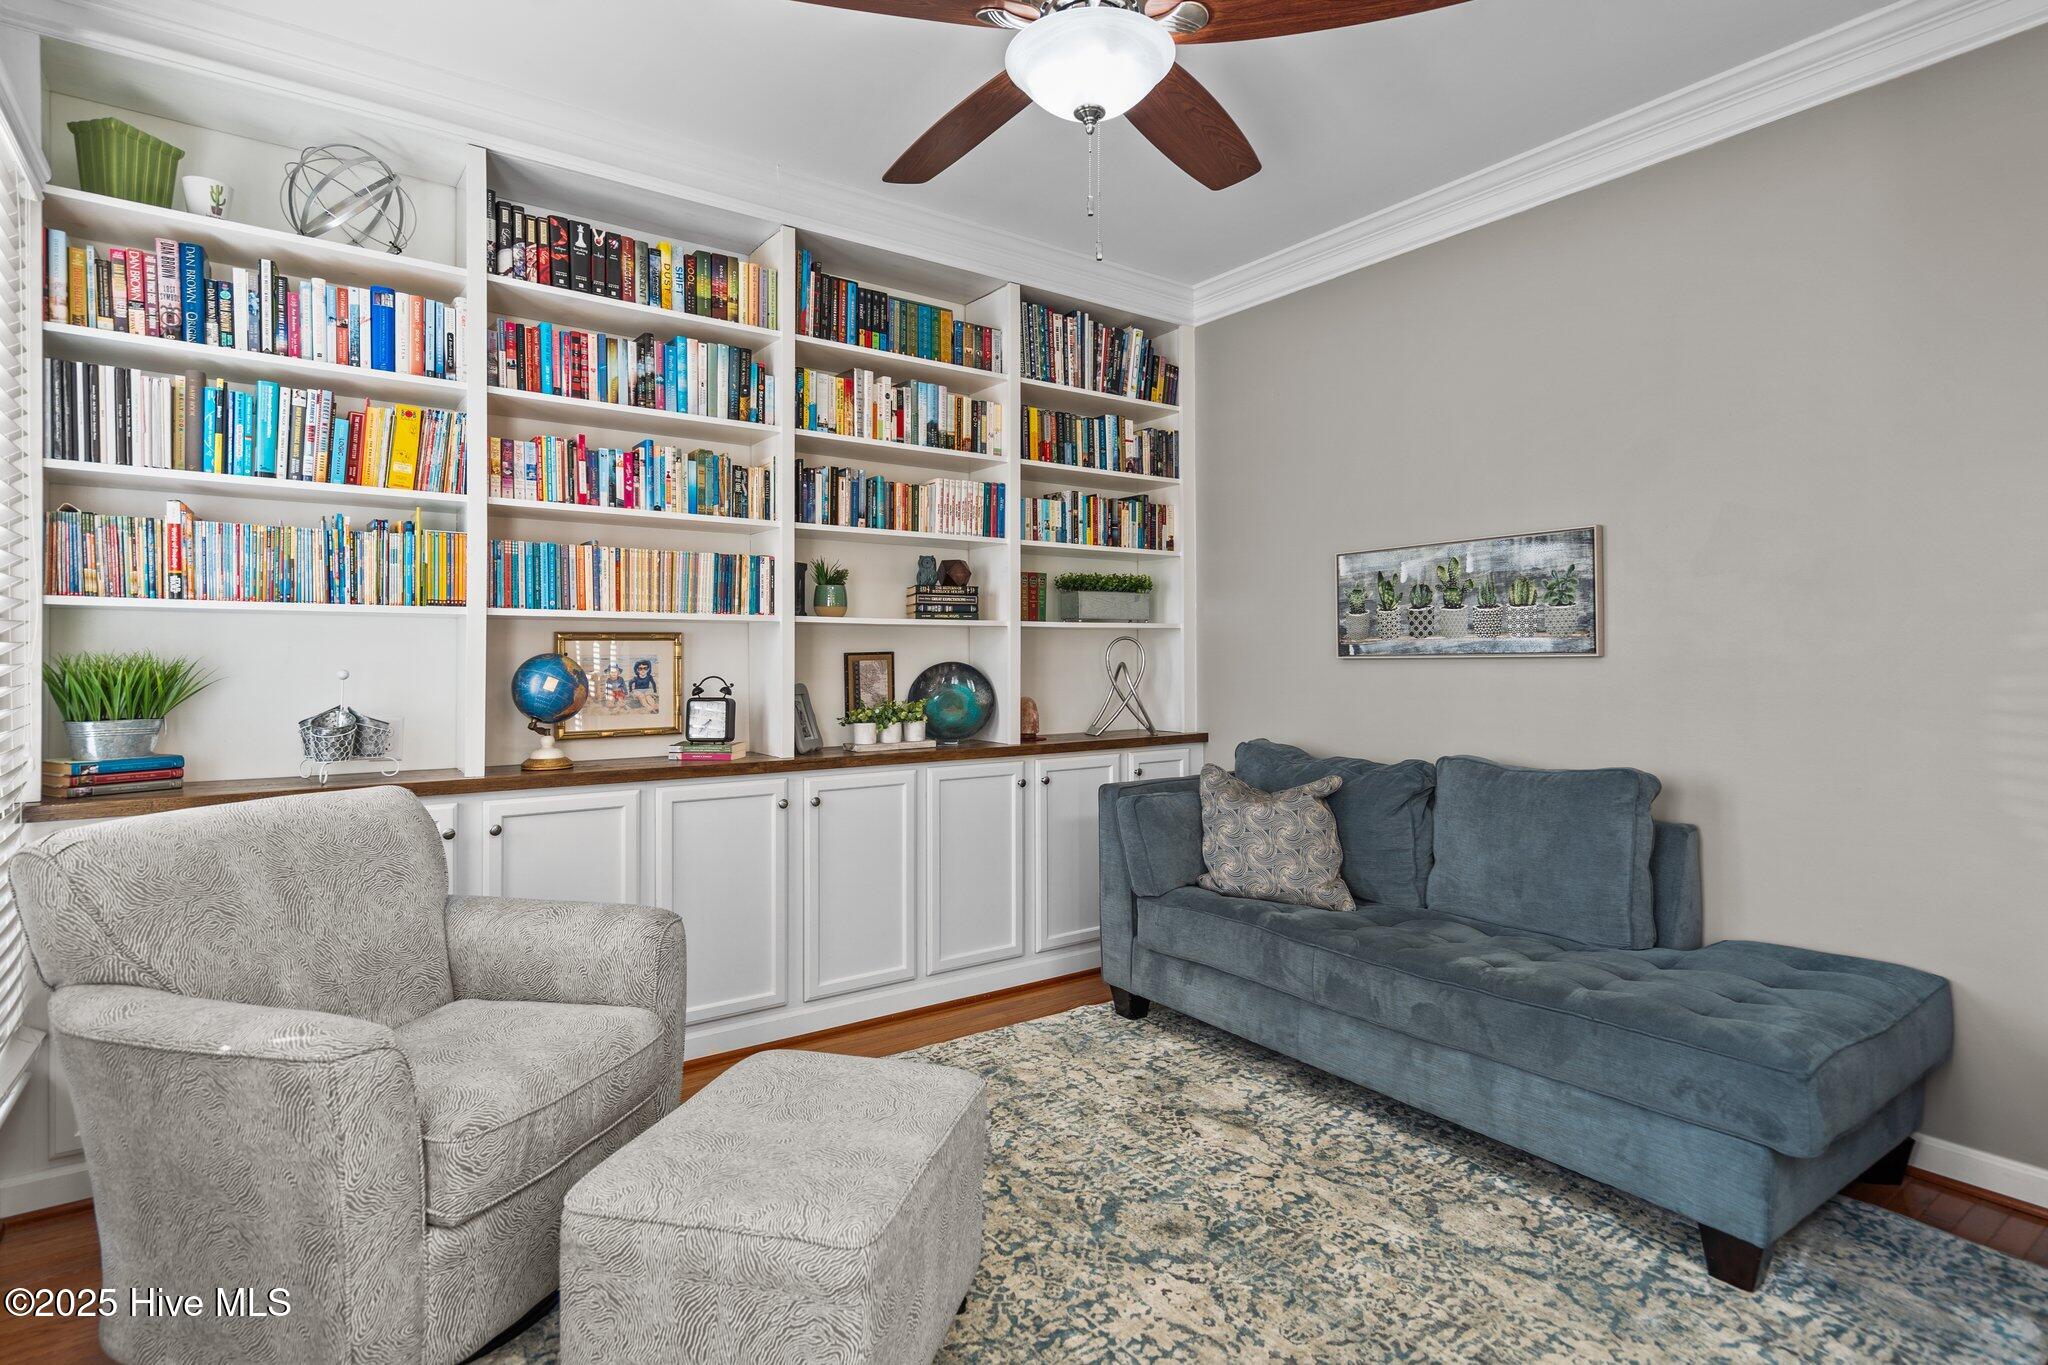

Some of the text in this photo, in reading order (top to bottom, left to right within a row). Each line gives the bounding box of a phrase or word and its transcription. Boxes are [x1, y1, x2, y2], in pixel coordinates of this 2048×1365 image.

[130, 250, 140, 270] DAN
[160, 242, 177, 281] DAN BROWN
[186, 246, 197, 267] DAN
[130, 270, 142, 302] BROWN
[186, 269, 197, 304] BROWN
[624, 252, 632, 297] ALLEGIANT
[664, 262, 672, 295] DUST
[675, 266, 684, 296] SHIFT
[220, 299, 232, 312] DAN
[220, 312, 232, 332] BROWN
[322, 398, 331, 420] ROCKET
[170, 576, 178, 593] WARS
